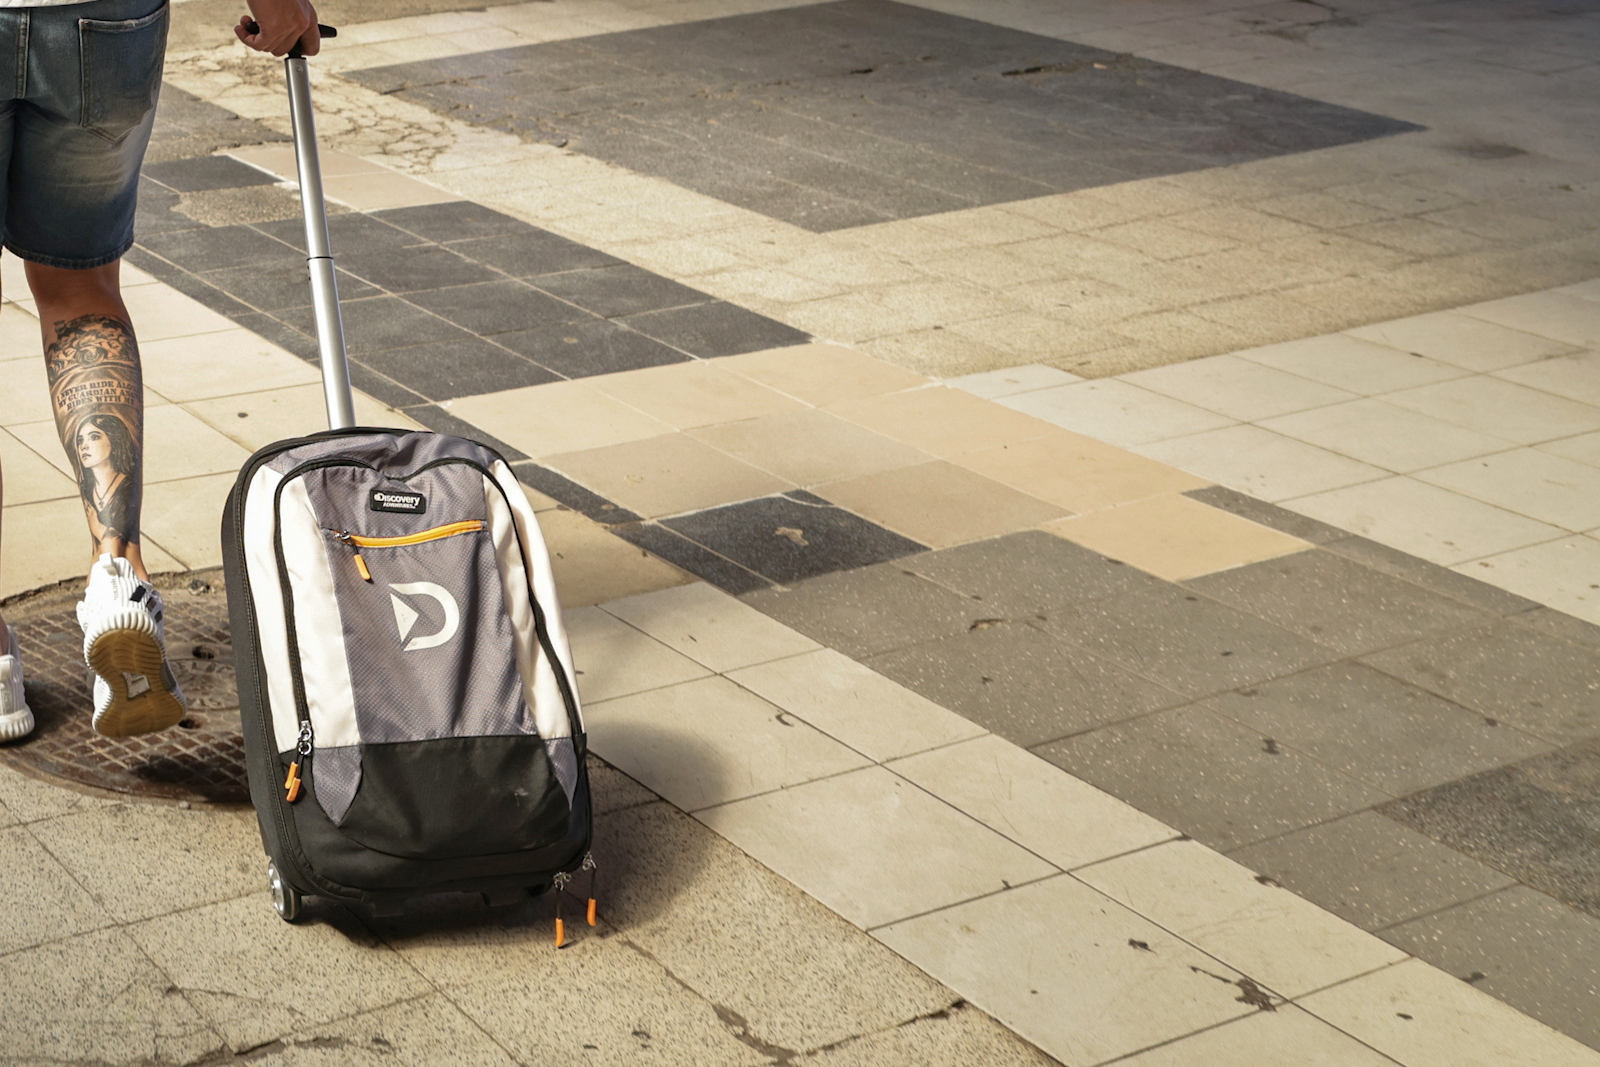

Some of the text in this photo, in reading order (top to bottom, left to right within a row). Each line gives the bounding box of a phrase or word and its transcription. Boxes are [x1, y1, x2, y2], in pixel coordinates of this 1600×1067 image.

[60, 384, 87, 399] NEVER
[89, 380, 114, 389] RIDE
[58, 399, 67, 410] MY
[68, 388, 117, 402] GUARDIAN
[66, 396, 93, 411] RIDES
[95, 395, 121, 403] WITH
[374, 493, 420, 507] Discovery
